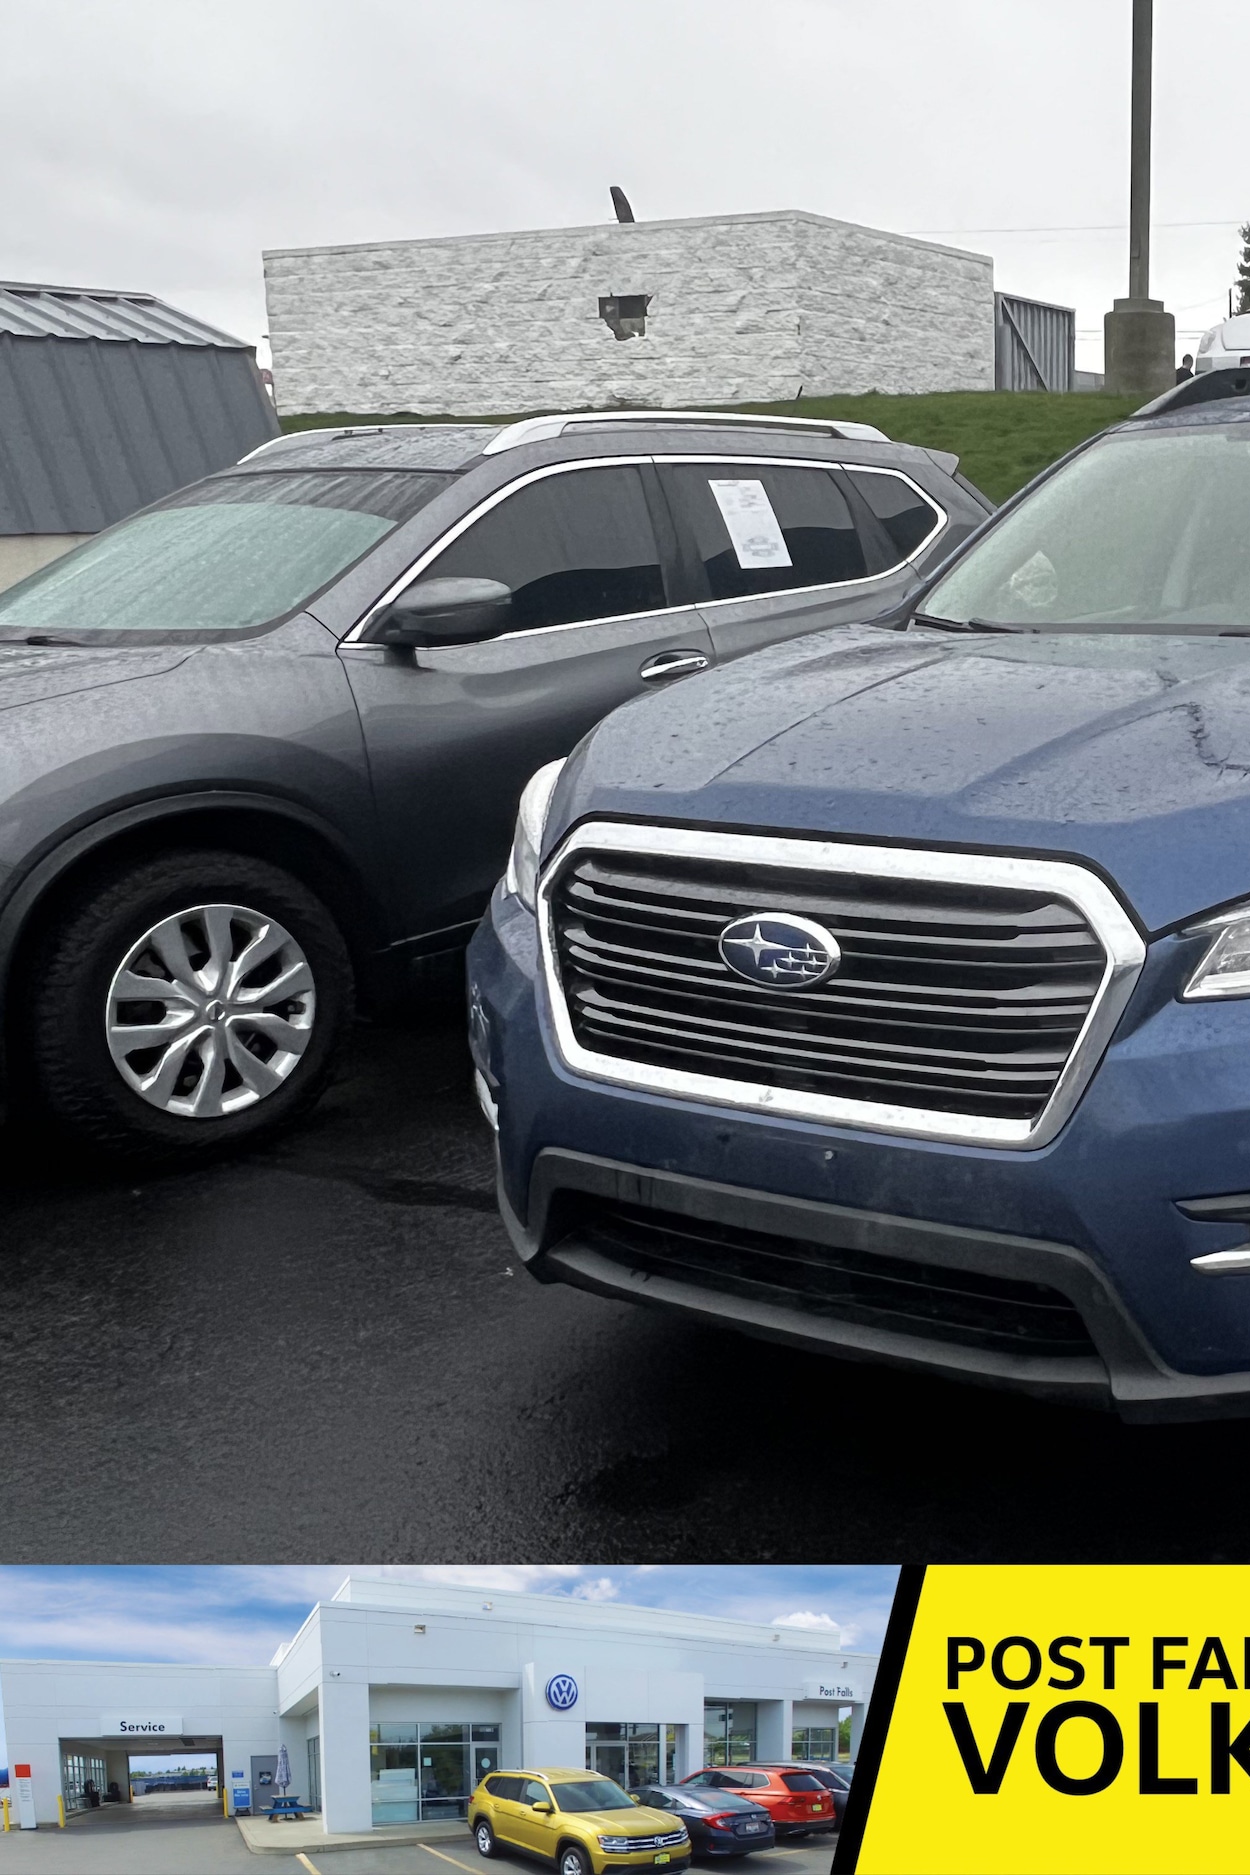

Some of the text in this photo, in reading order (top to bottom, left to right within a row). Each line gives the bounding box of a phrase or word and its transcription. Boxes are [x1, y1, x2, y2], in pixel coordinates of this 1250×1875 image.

[819, 1686, 853, 1697] Post Falls
[119, 1720, 166, 1732] Service
